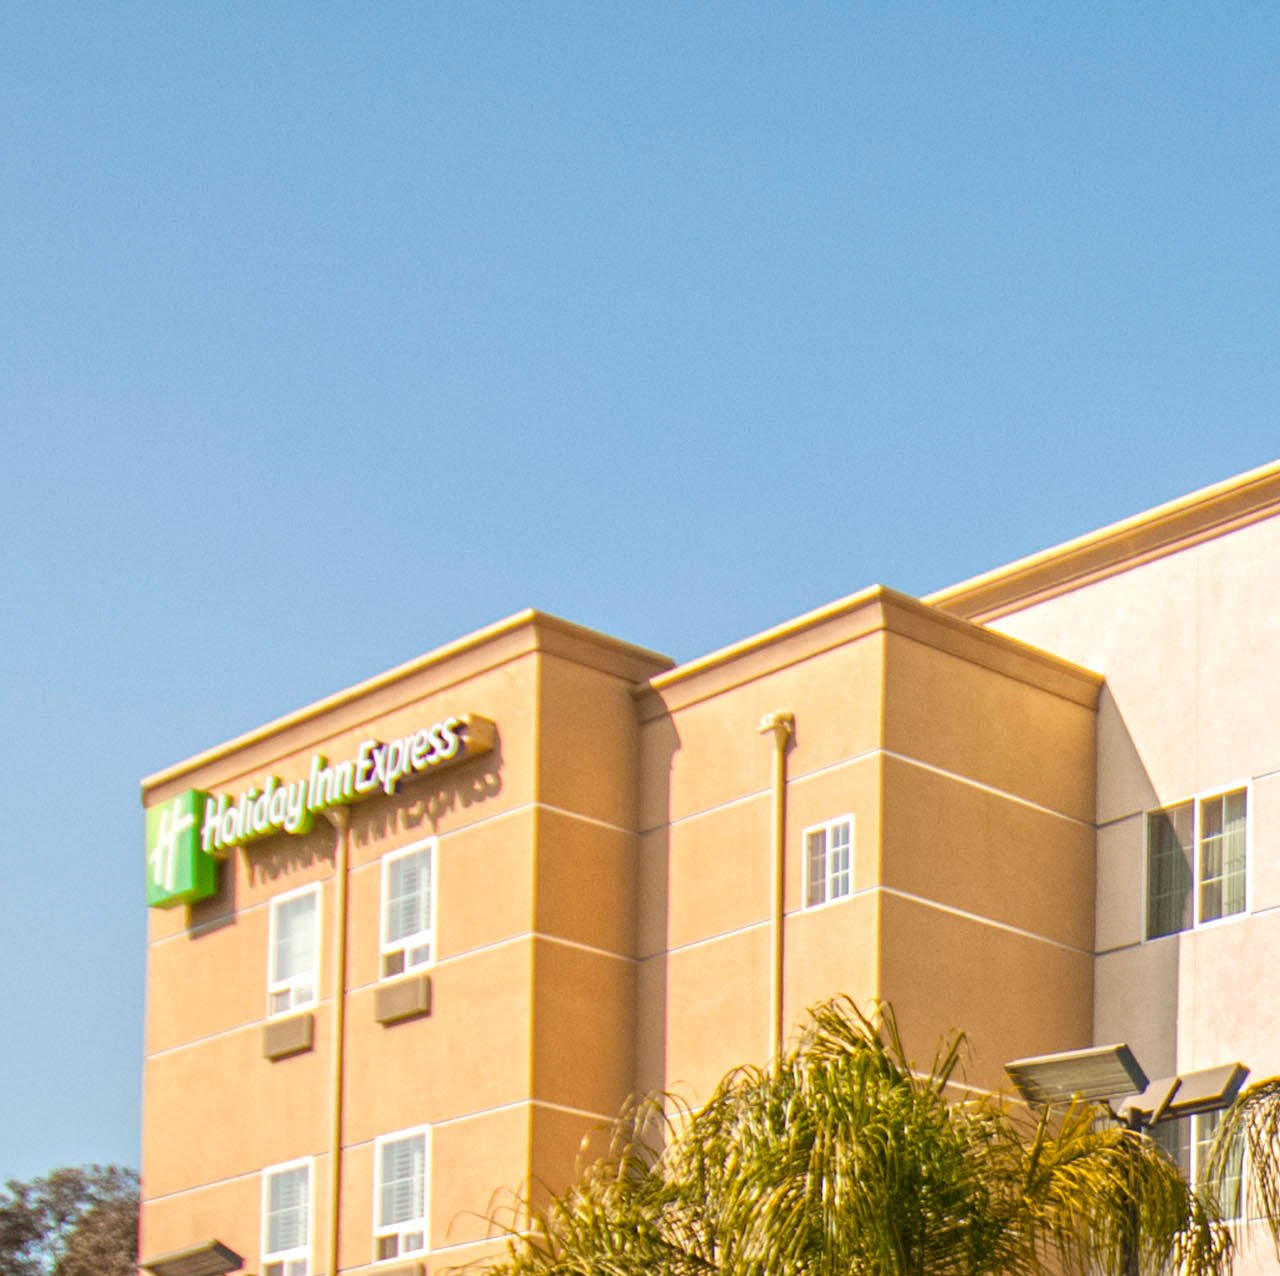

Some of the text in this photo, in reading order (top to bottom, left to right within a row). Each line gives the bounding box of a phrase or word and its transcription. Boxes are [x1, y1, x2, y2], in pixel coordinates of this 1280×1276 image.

[202, 717, 460, 853] Holiday Inn Express
